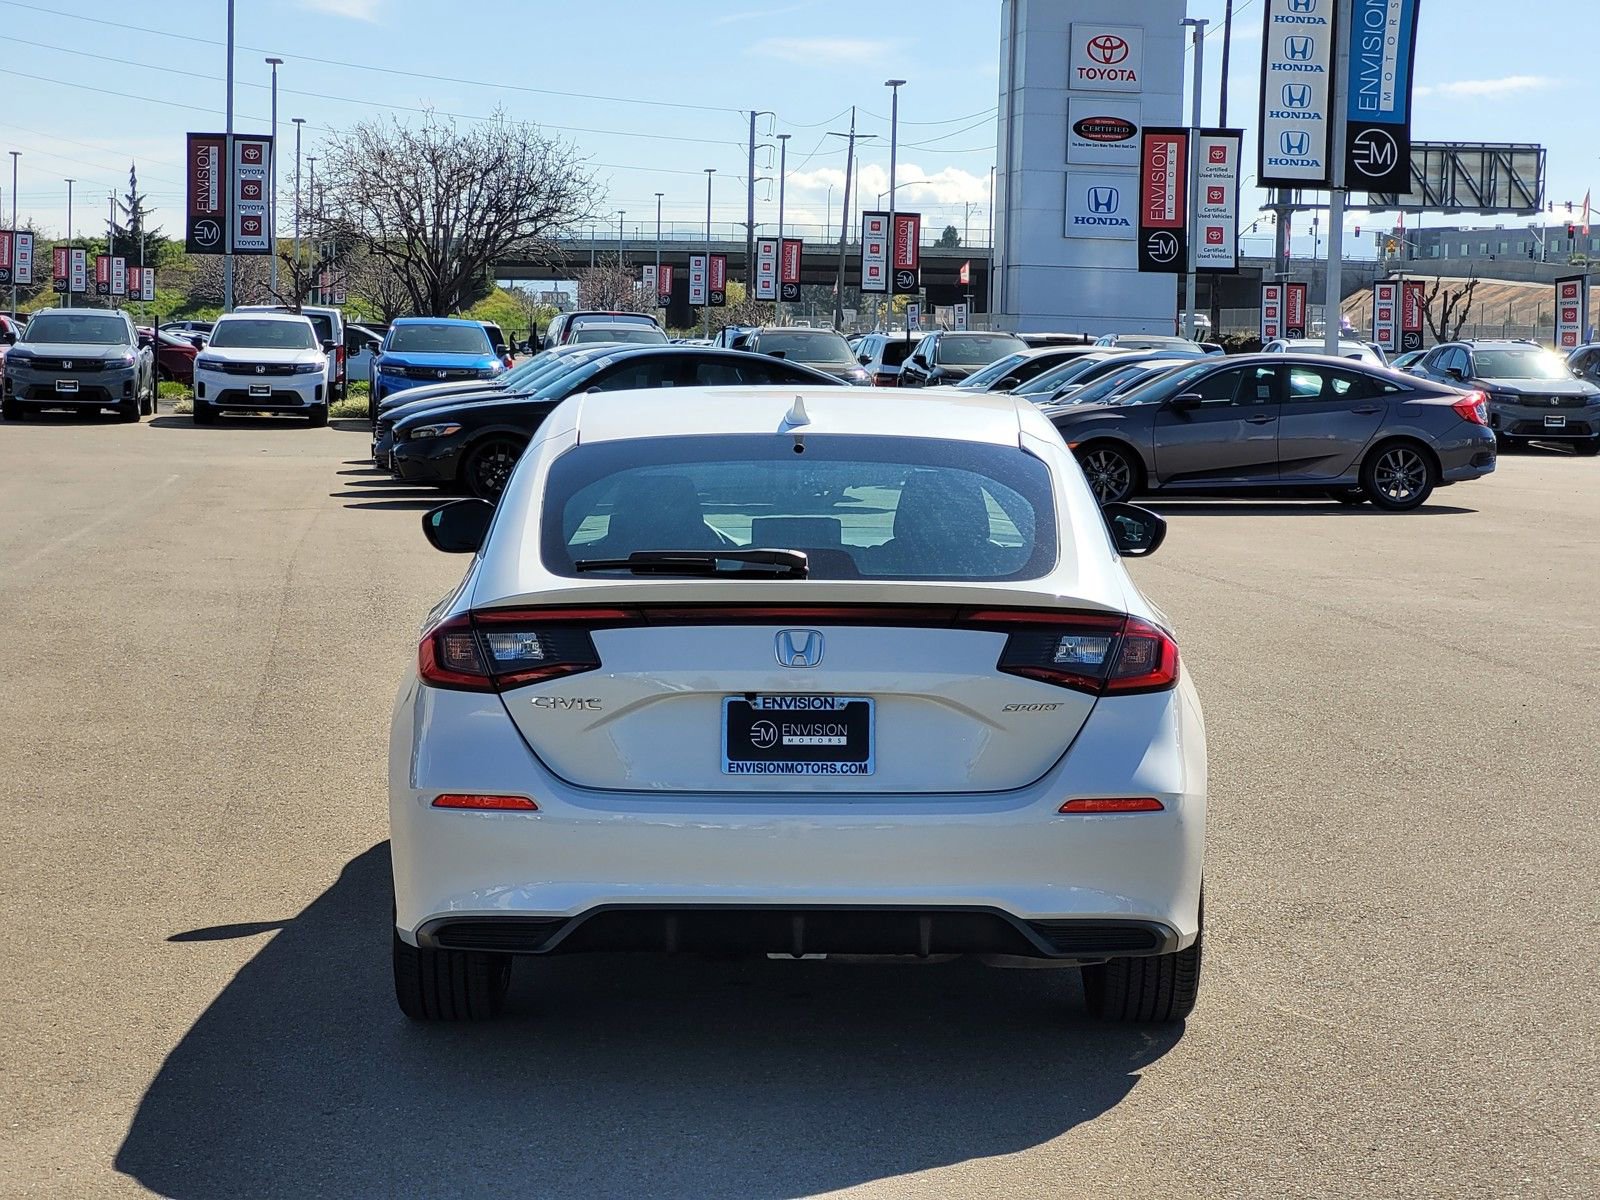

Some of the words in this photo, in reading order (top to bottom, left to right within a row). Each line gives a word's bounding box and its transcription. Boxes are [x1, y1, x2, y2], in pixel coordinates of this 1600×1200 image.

[1274, 16, 1327, 24] HONDA
[1384, 3, 1398, 101] MOTORS
[1272, 64, 1324, 72] HONDA
[1077, 68, 1136, 81] TOYOTA
[1269, 111, 1322, 119] HONDA
[1268, 158, 1320, 167] HONDA
[197, 146, 208, 210] ENVISION
[1151, 142, 1166, 220] ENVISION
[1074, 216, 1130, 226] HONDA
[899, 221, 907, 264] ENVISION
[532, 697, 602, 710] CIVIC
[763, 698, 834, 710] ENVISION
[1002, 703, 1064, 712] SPORT
[783, 724, 847, 735] ENVISION
[728, 763, 868, 774] ENVISIONMOTORS.COM
